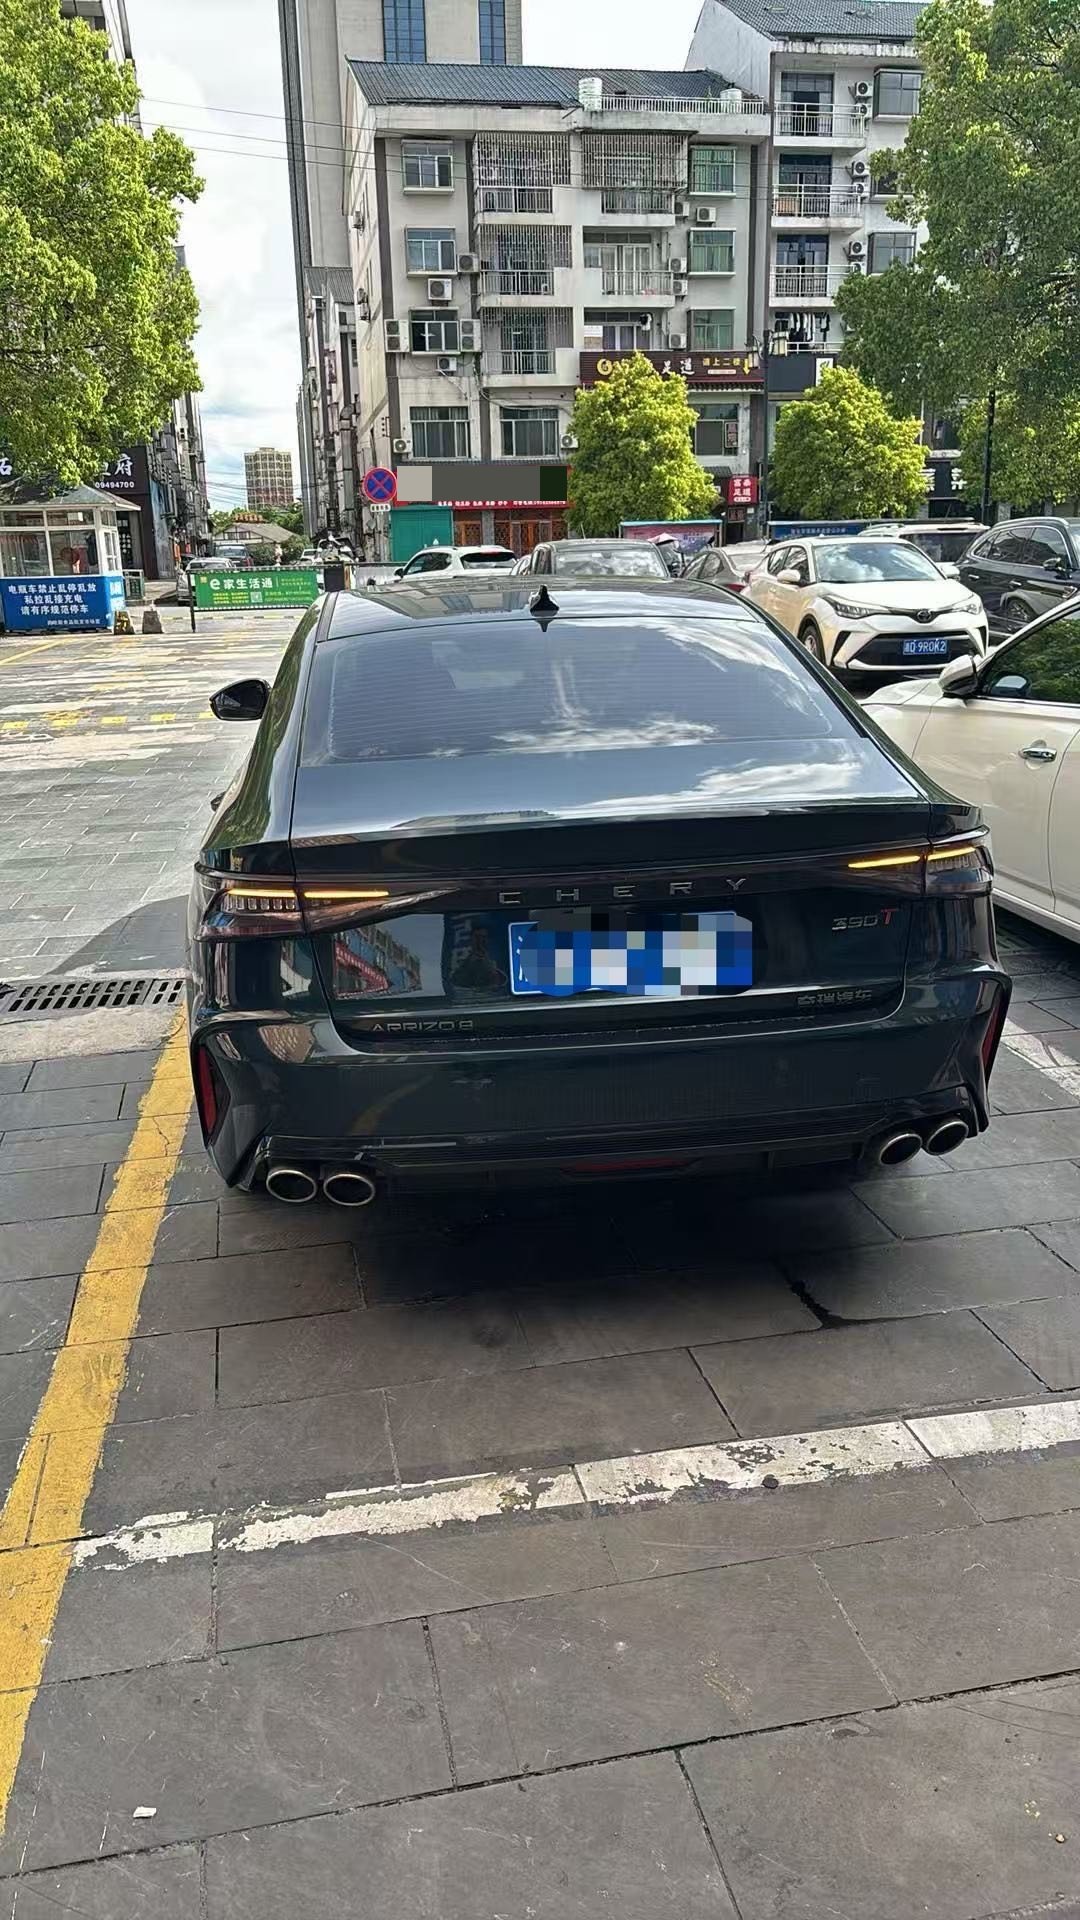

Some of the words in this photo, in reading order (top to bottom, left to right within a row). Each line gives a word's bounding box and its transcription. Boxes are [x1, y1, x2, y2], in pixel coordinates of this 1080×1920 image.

[8, 583, 97, 594] 电瓶车禁止乱停乱放
[209, 578, 273, 590] e家生活通
[24, 594, 83, 604] 私拉乱接充电
[20, 604, 88, 615] 请有序规范停车
[499, 878, 747, 904] CHERY
